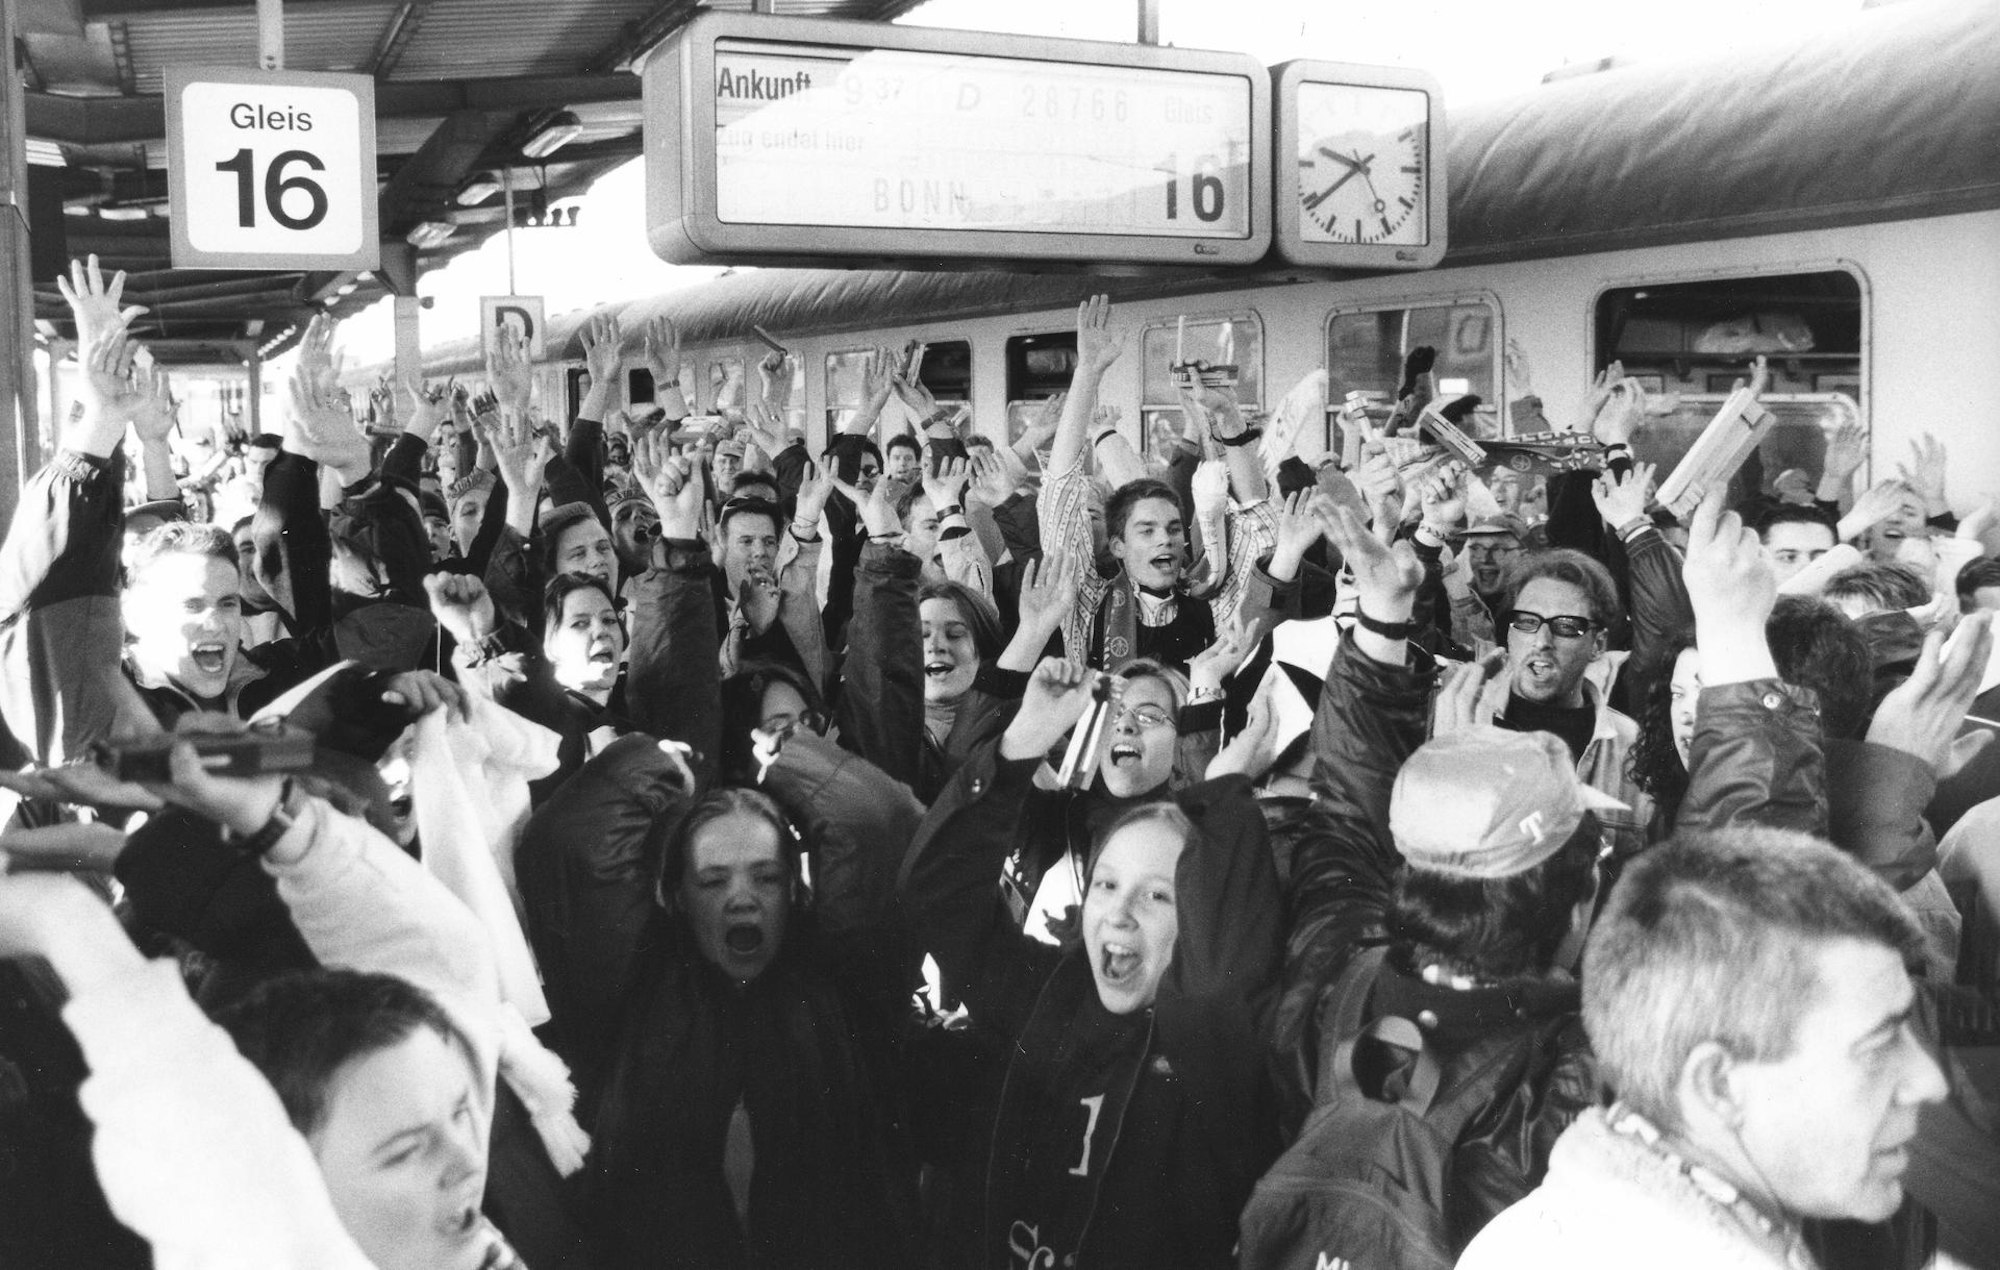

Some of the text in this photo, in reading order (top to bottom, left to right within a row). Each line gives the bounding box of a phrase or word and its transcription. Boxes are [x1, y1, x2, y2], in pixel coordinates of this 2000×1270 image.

[717, 67, 811, 100] Ankunft
[230, 103, 313, 132] Gleis
[215, 148, 328, 231] 16
[1153, 152, 1224, 222] 16
